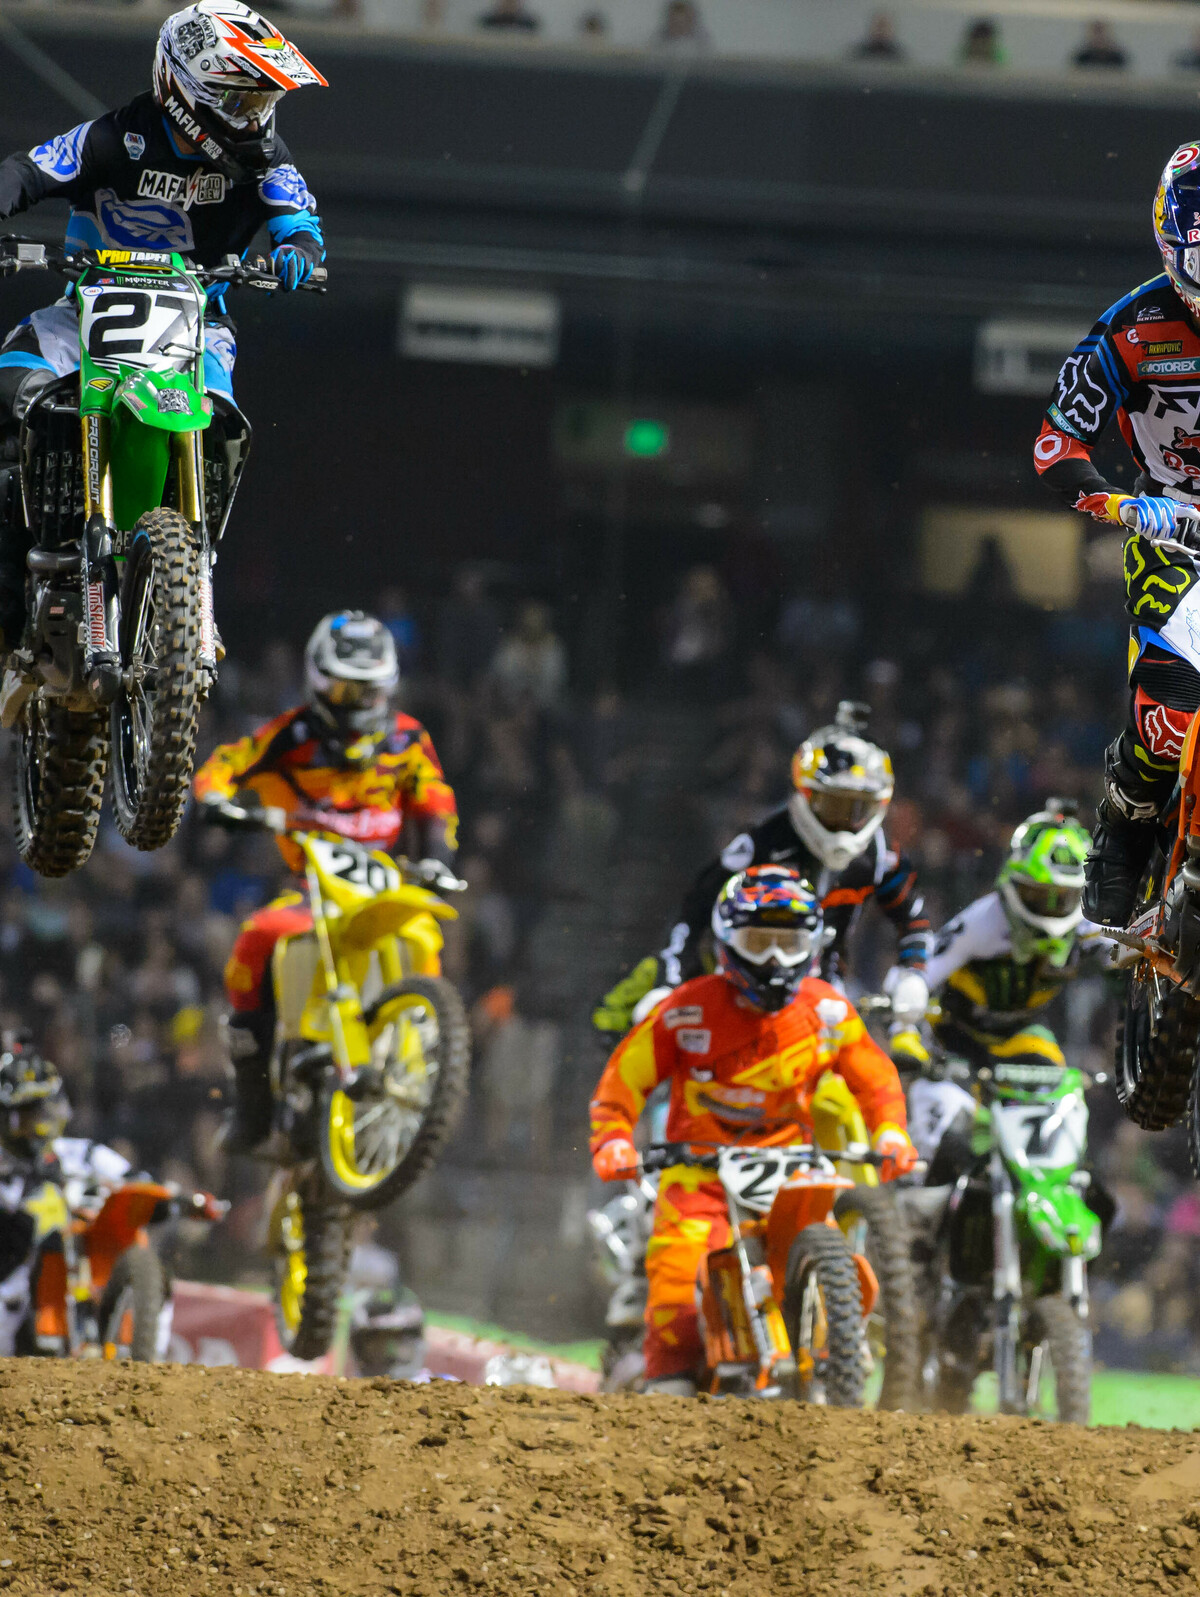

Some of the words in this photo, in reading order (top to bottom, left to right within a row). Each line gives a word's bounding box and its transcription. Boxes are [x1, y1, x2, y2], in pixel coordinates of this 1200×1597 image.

[164, 96, 202, 140] MAFIA
[201, 142, 220, 160] CREW
[204, 137, 223, 155] MOTO
[140, 171, 189, 200] MAFIA
[88, 292, 199, 354] 27
[1147, 360, 1196, 374] MOTOREX
[89, 416, 99, 447] PRO
[89, 447, 101, 504] CIRCUIT
